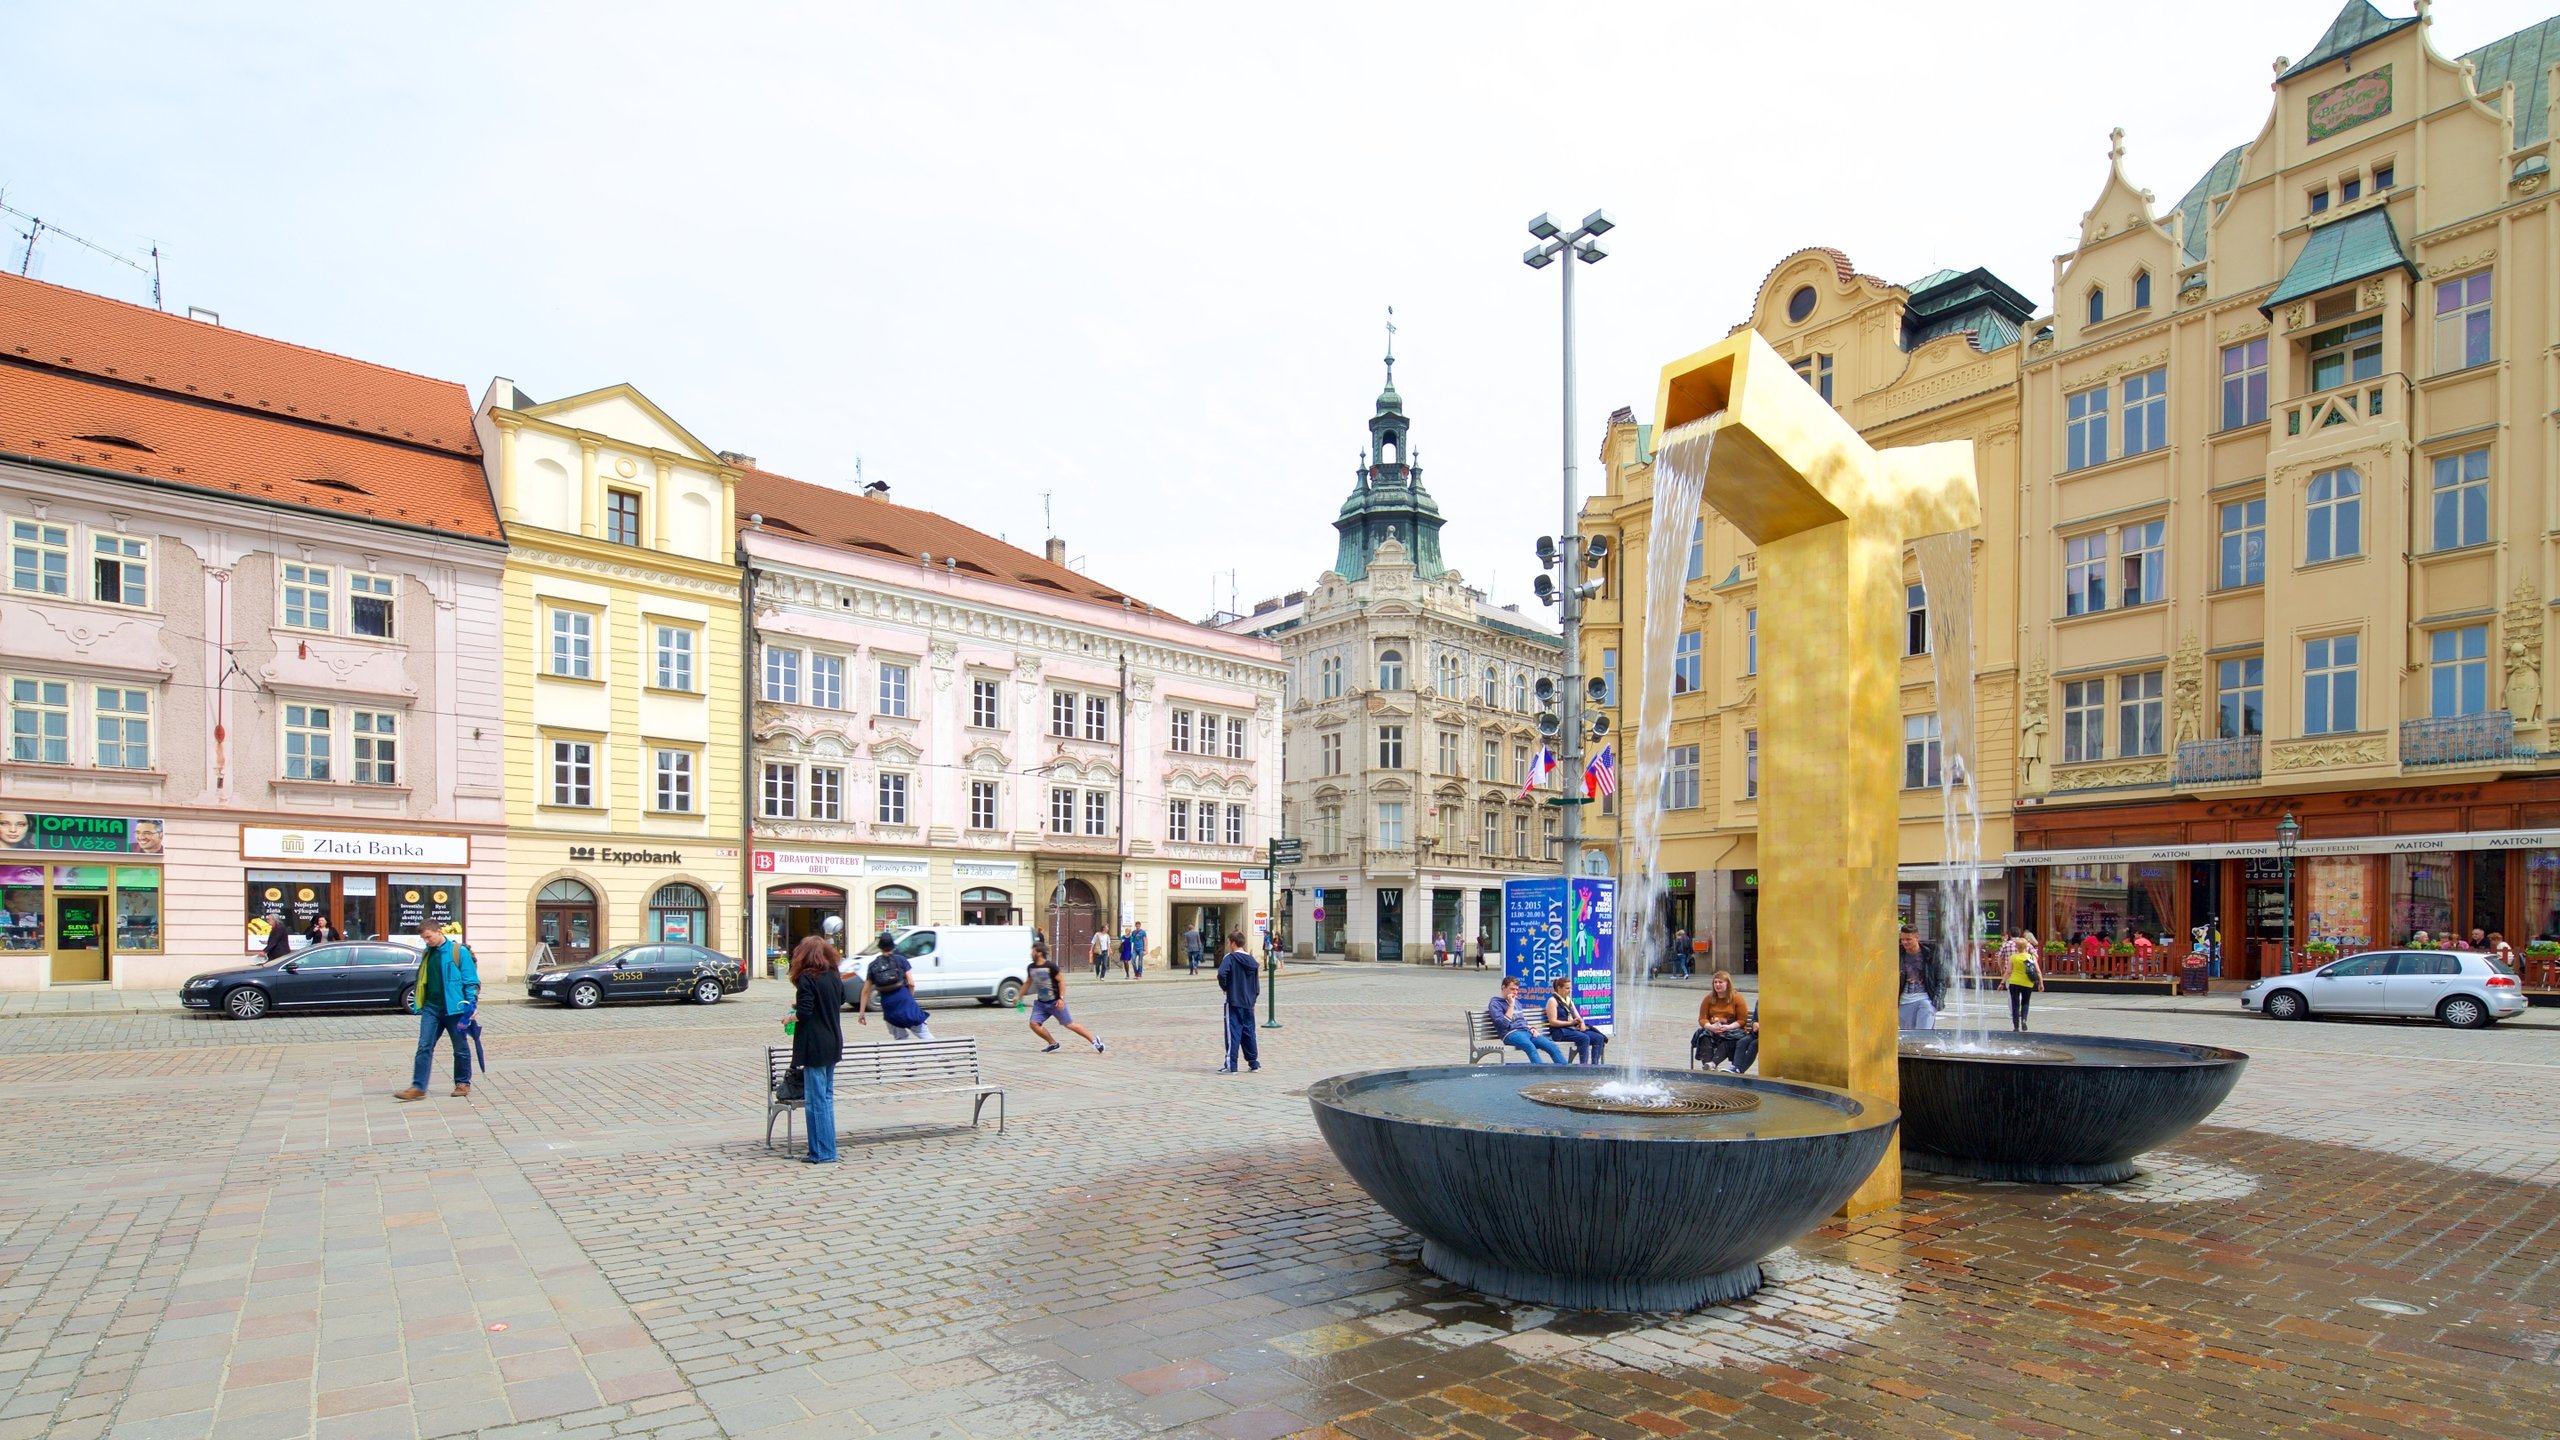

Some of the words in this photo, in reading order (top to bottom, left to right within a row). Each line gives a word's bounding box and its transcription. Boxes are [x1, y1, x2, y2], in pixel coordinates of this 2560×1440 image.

[2343, 786, 2482, 808] Fellini
[43, 817, 123, 833] OPTIKA
[50, 835, 63, 849] U
[70, 835, 117, 850] Věže
[2394, 841, 2443, 850] MATTONI
[2489, 837, 2543, 846] MATTONI
[313, 838, 362, 854] Zlatá
[369, 841, 424, 856] Banka
[2299, 846, 2324, 854] CAFFE
[2327, 844, 2360, 852] FELLINI
[2152, 851, 2191, 859] MATTONI
[2226, 848, 2268, 856] MATTONI
[602, 848, 682, 866] Expobank
[779, 854, 824, 865] ZDRAVOTNÍ
[825, 855, 860, 866] POTŘEBY
[2018, 856, 2052, 864] MATTONI
[2099, 853, 2125, 861] FELLINI
[808, 865, 830, 874] OBUV
[871, 864, 900, 873] potraviny
[1184, 874, 1218, 885] intima
[1382, 890, 1399, 906] W
[294, 901, 319, 909] Nejlepší
[1524, 901, 1541, 910] 2015
[1548, 897, 1563, 984] EVROPY
[1533, 937, 1546, 983] DEN
[612, 972, 643, 981] sassa
[1577, 968, 1611, 978] MOTÖRHEAD
[1578, 983, 1597, 991] GUANO
